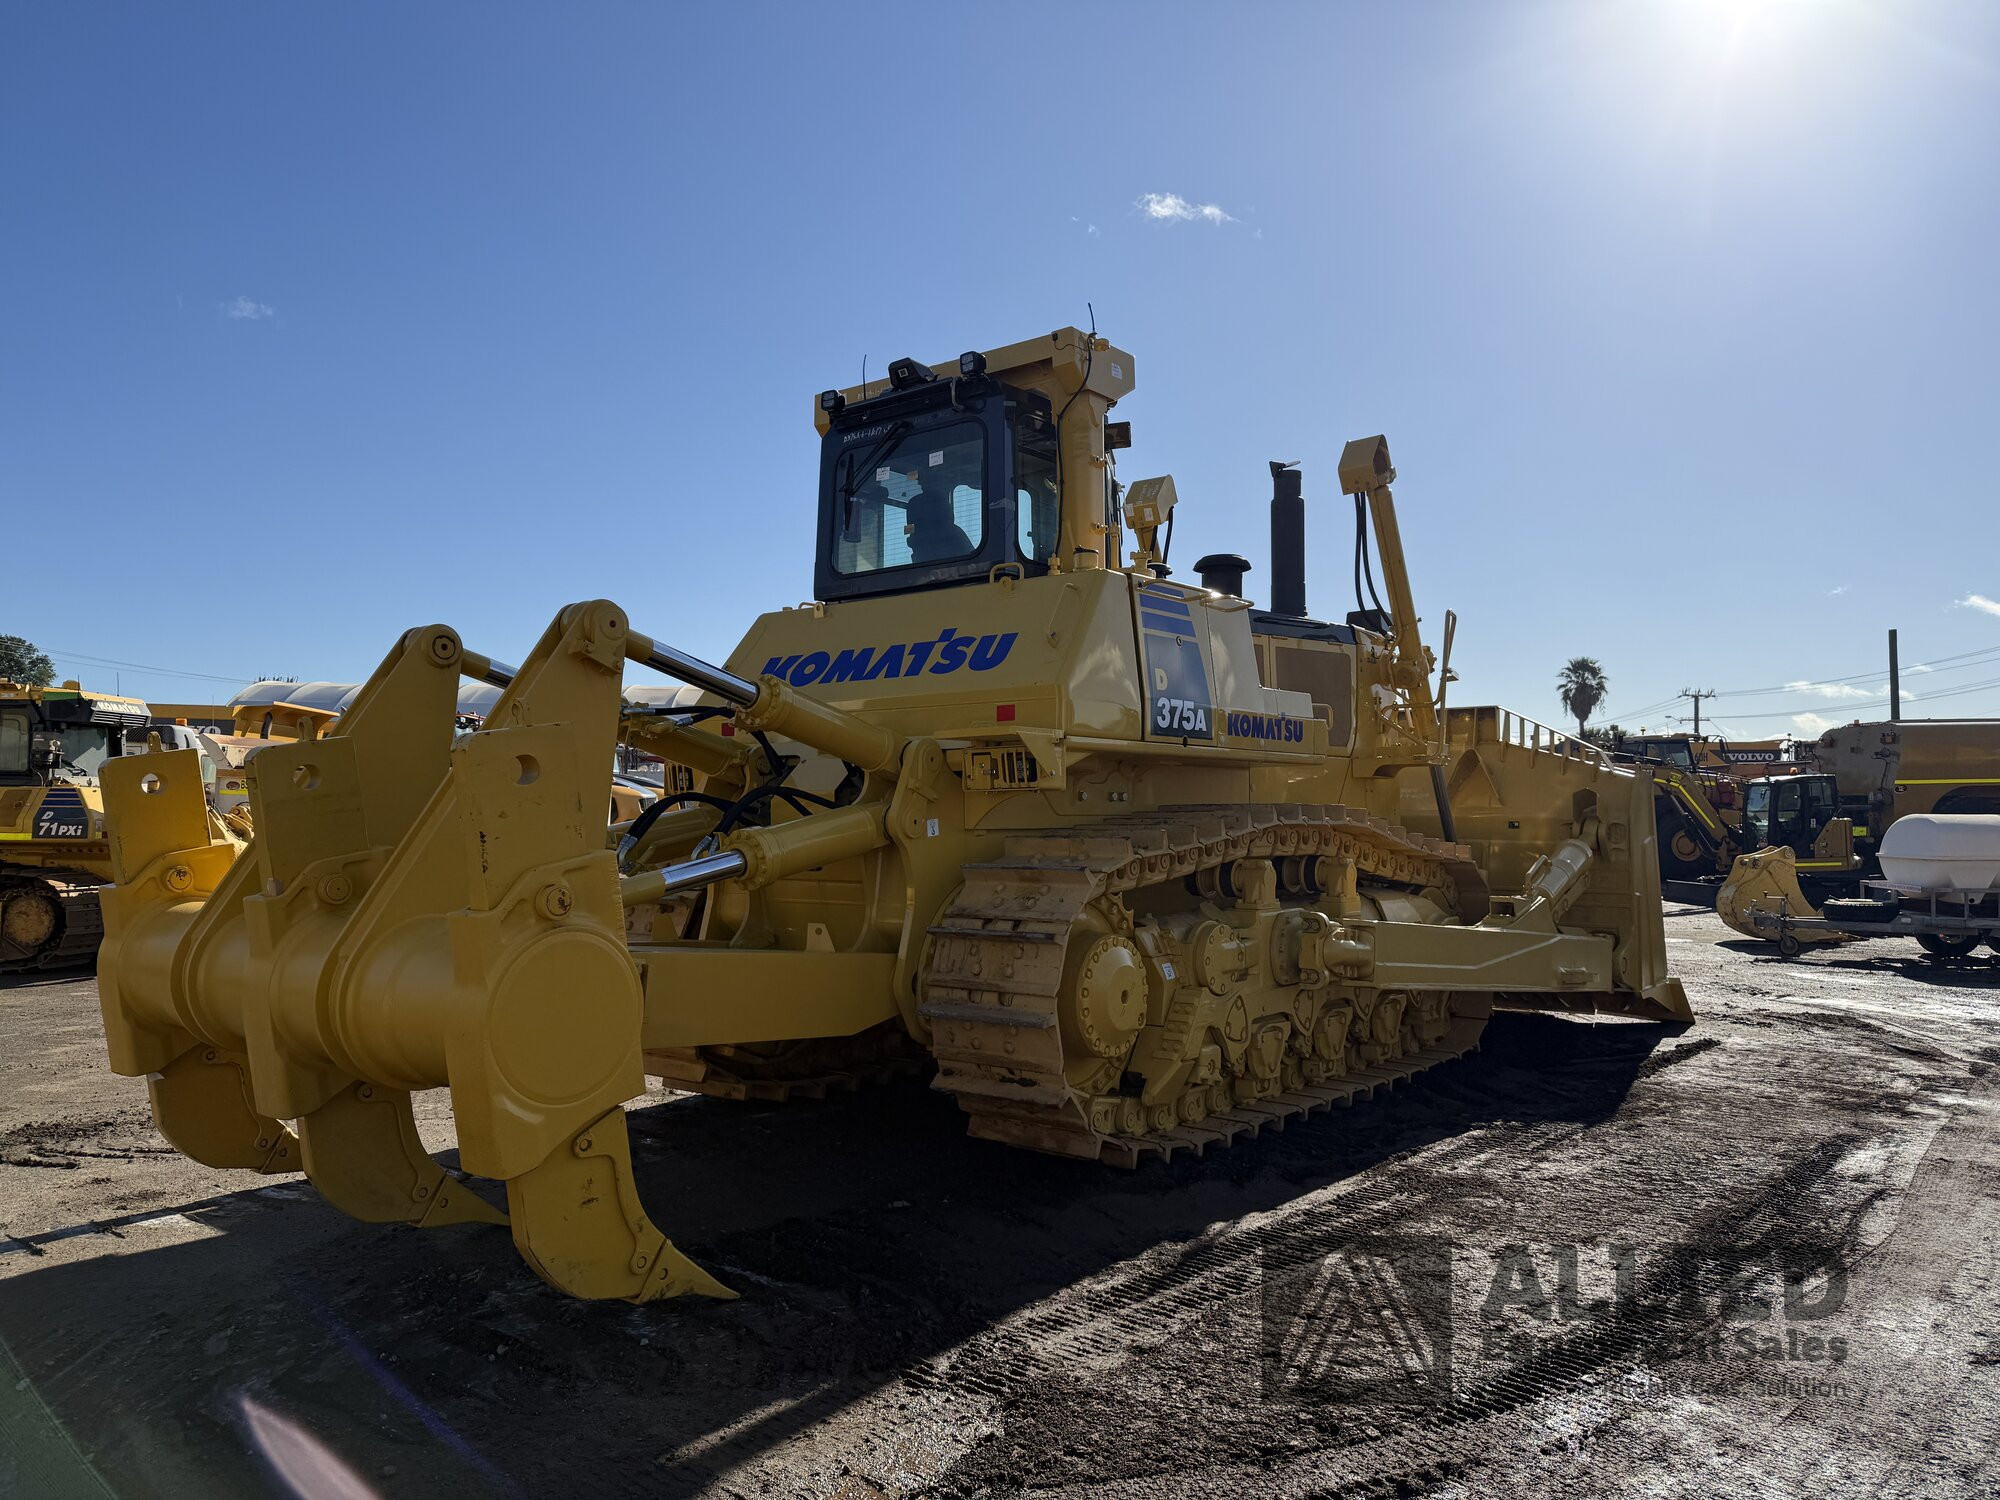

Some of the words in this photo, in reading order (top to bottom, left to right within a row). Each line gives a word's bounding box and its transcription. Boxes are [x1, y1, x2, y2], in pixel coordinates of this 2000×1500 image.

[761, 627, 1019, 687] KOMATSU
[1155, 668, 1168, 691] D
[97, 701, 141, 714] KOMATSU
[1156, 697, 1207, 732] 375A
[1227, 712, 1304, 743] KOMATSU
[1728, 752, 1775, 761] VOLVO
[41, 811, 54, 820] D
[38, 822, 83, 836] 71PXi
